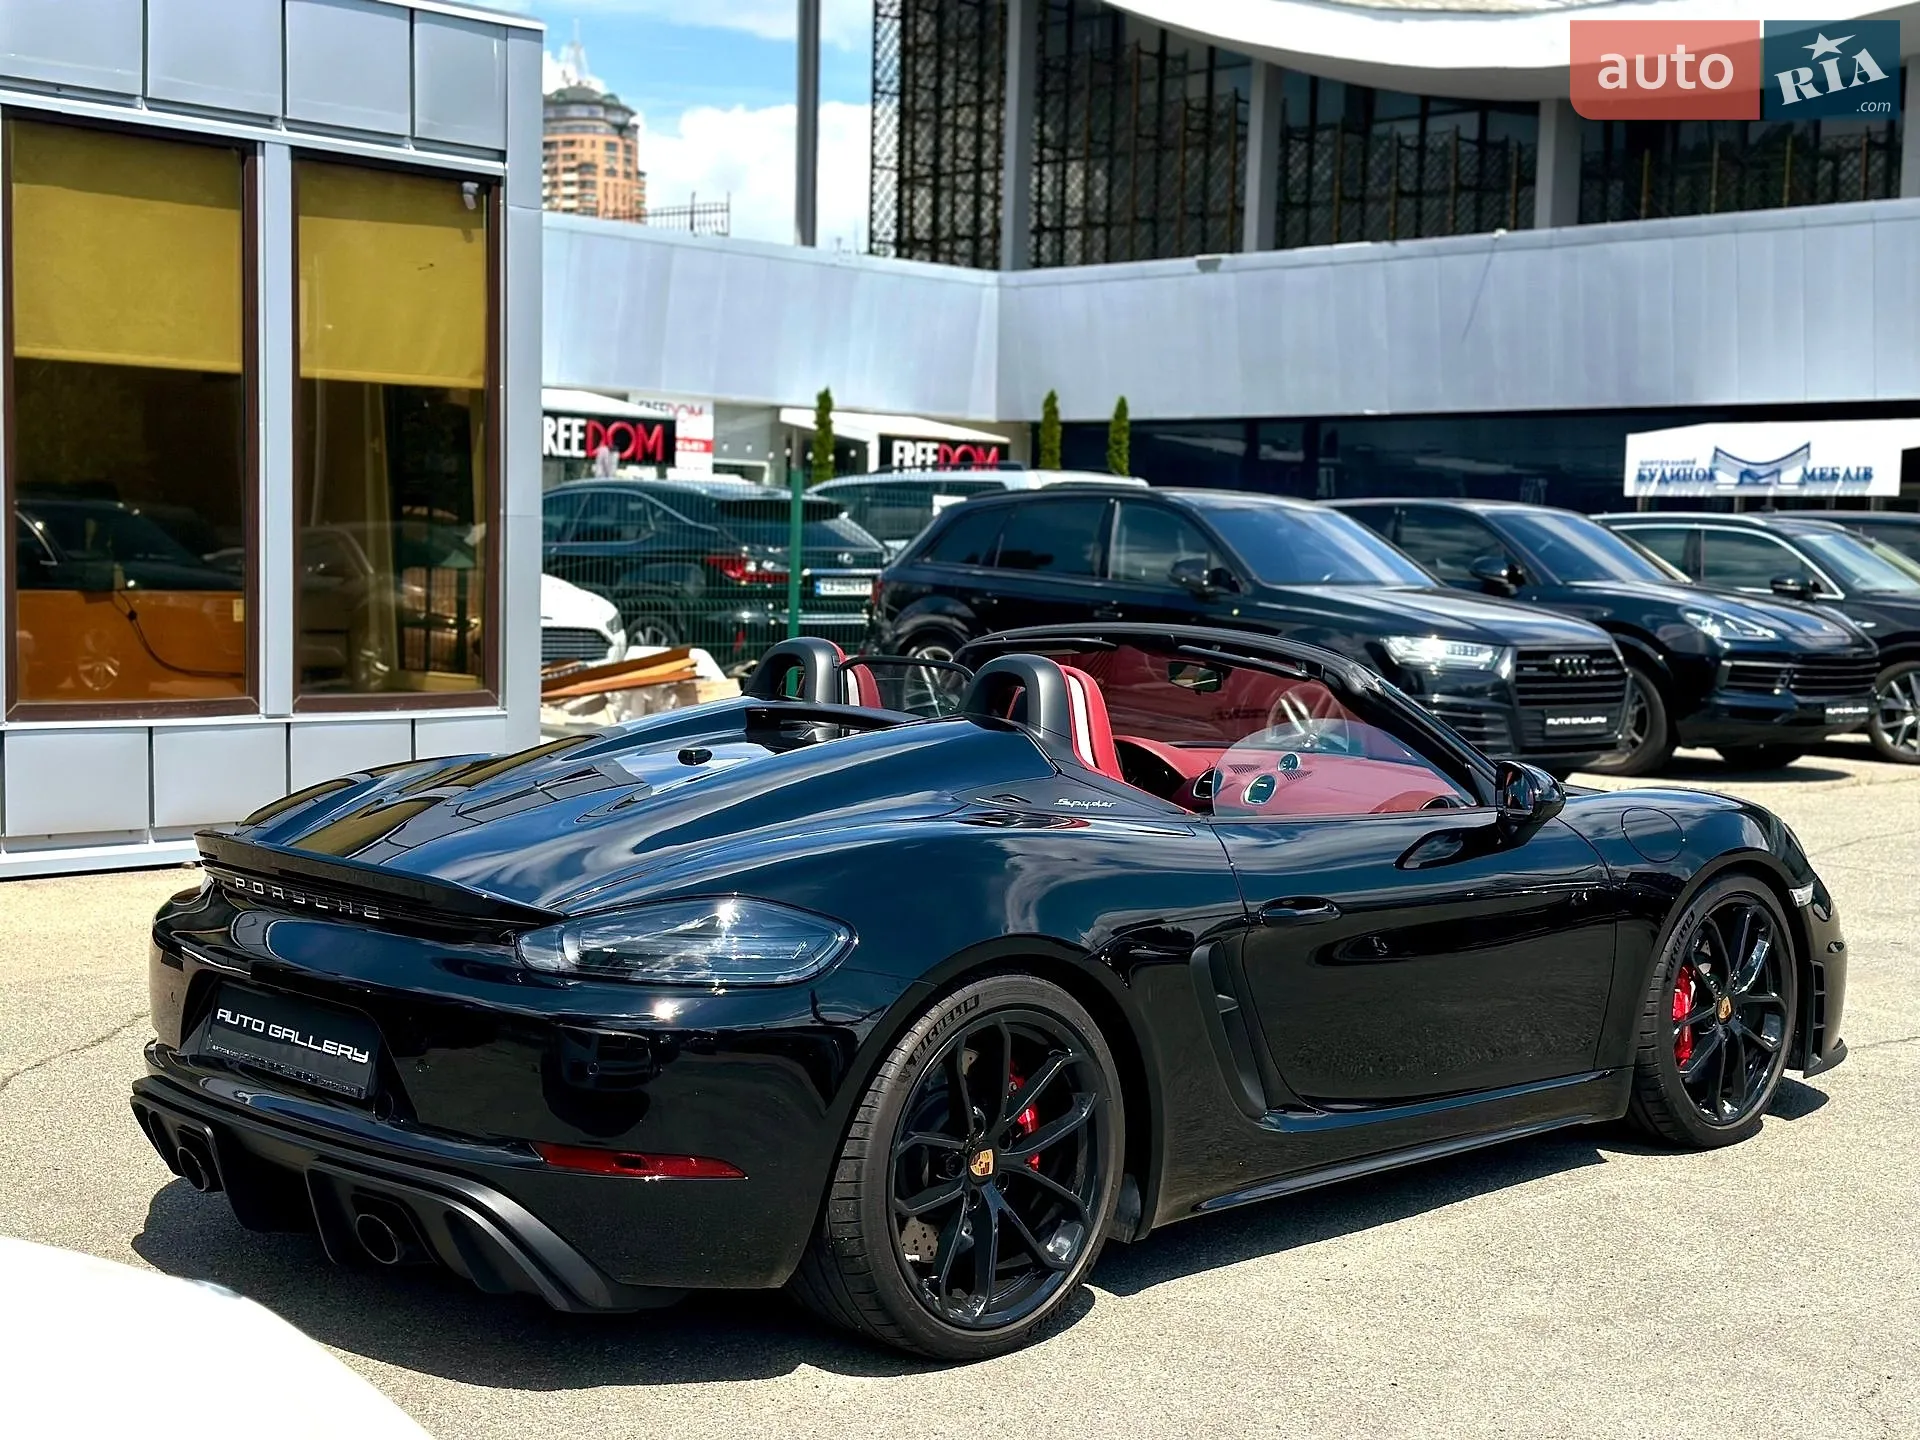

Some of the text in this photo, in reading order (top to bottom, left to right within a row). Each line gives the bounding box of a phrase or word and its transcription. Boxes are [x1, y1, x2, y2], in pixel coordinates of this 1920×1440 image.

[543, 416, 664, 462] REEDOM
[892, 440, 999, 467] FREEDOM
[1054, 798, 1116, 809] Spyder
[235, 877, 380, 919] PORSCHE
[217, 1008, 369, 1064] AUTO GALLERY
